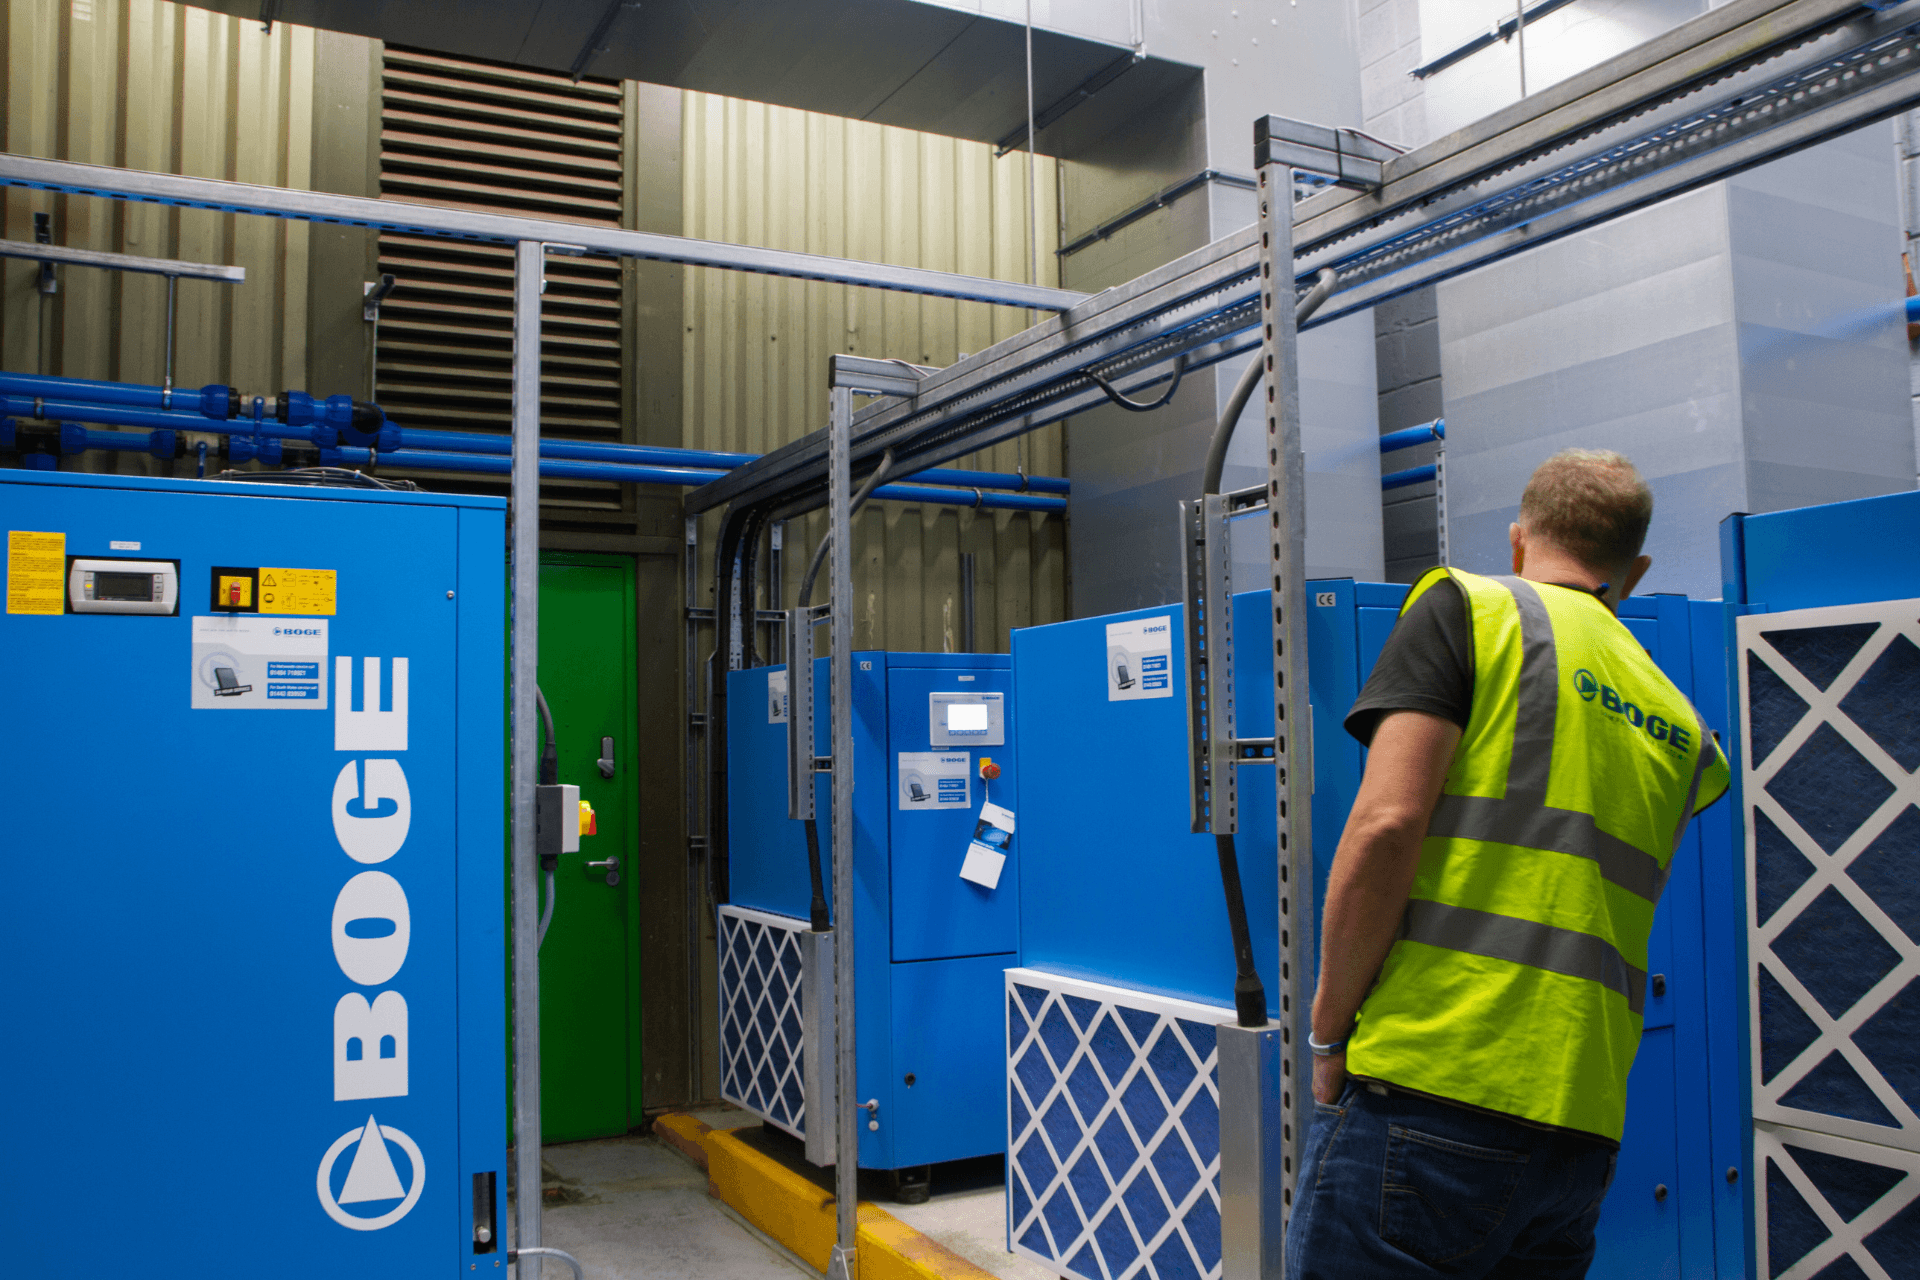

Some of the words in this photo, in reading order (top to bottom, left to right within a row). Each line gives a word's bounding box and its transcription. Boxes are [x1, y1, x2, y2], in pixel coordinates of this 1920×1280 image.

[1319, 594, 1333, 605] CE
[283, 628, 321, 636] BOGE
[1148, 625, 1167, 633] BOGE
[1601, 684, 1690, 754] BOGE
[331, 656, 411, 1102] BOGE
